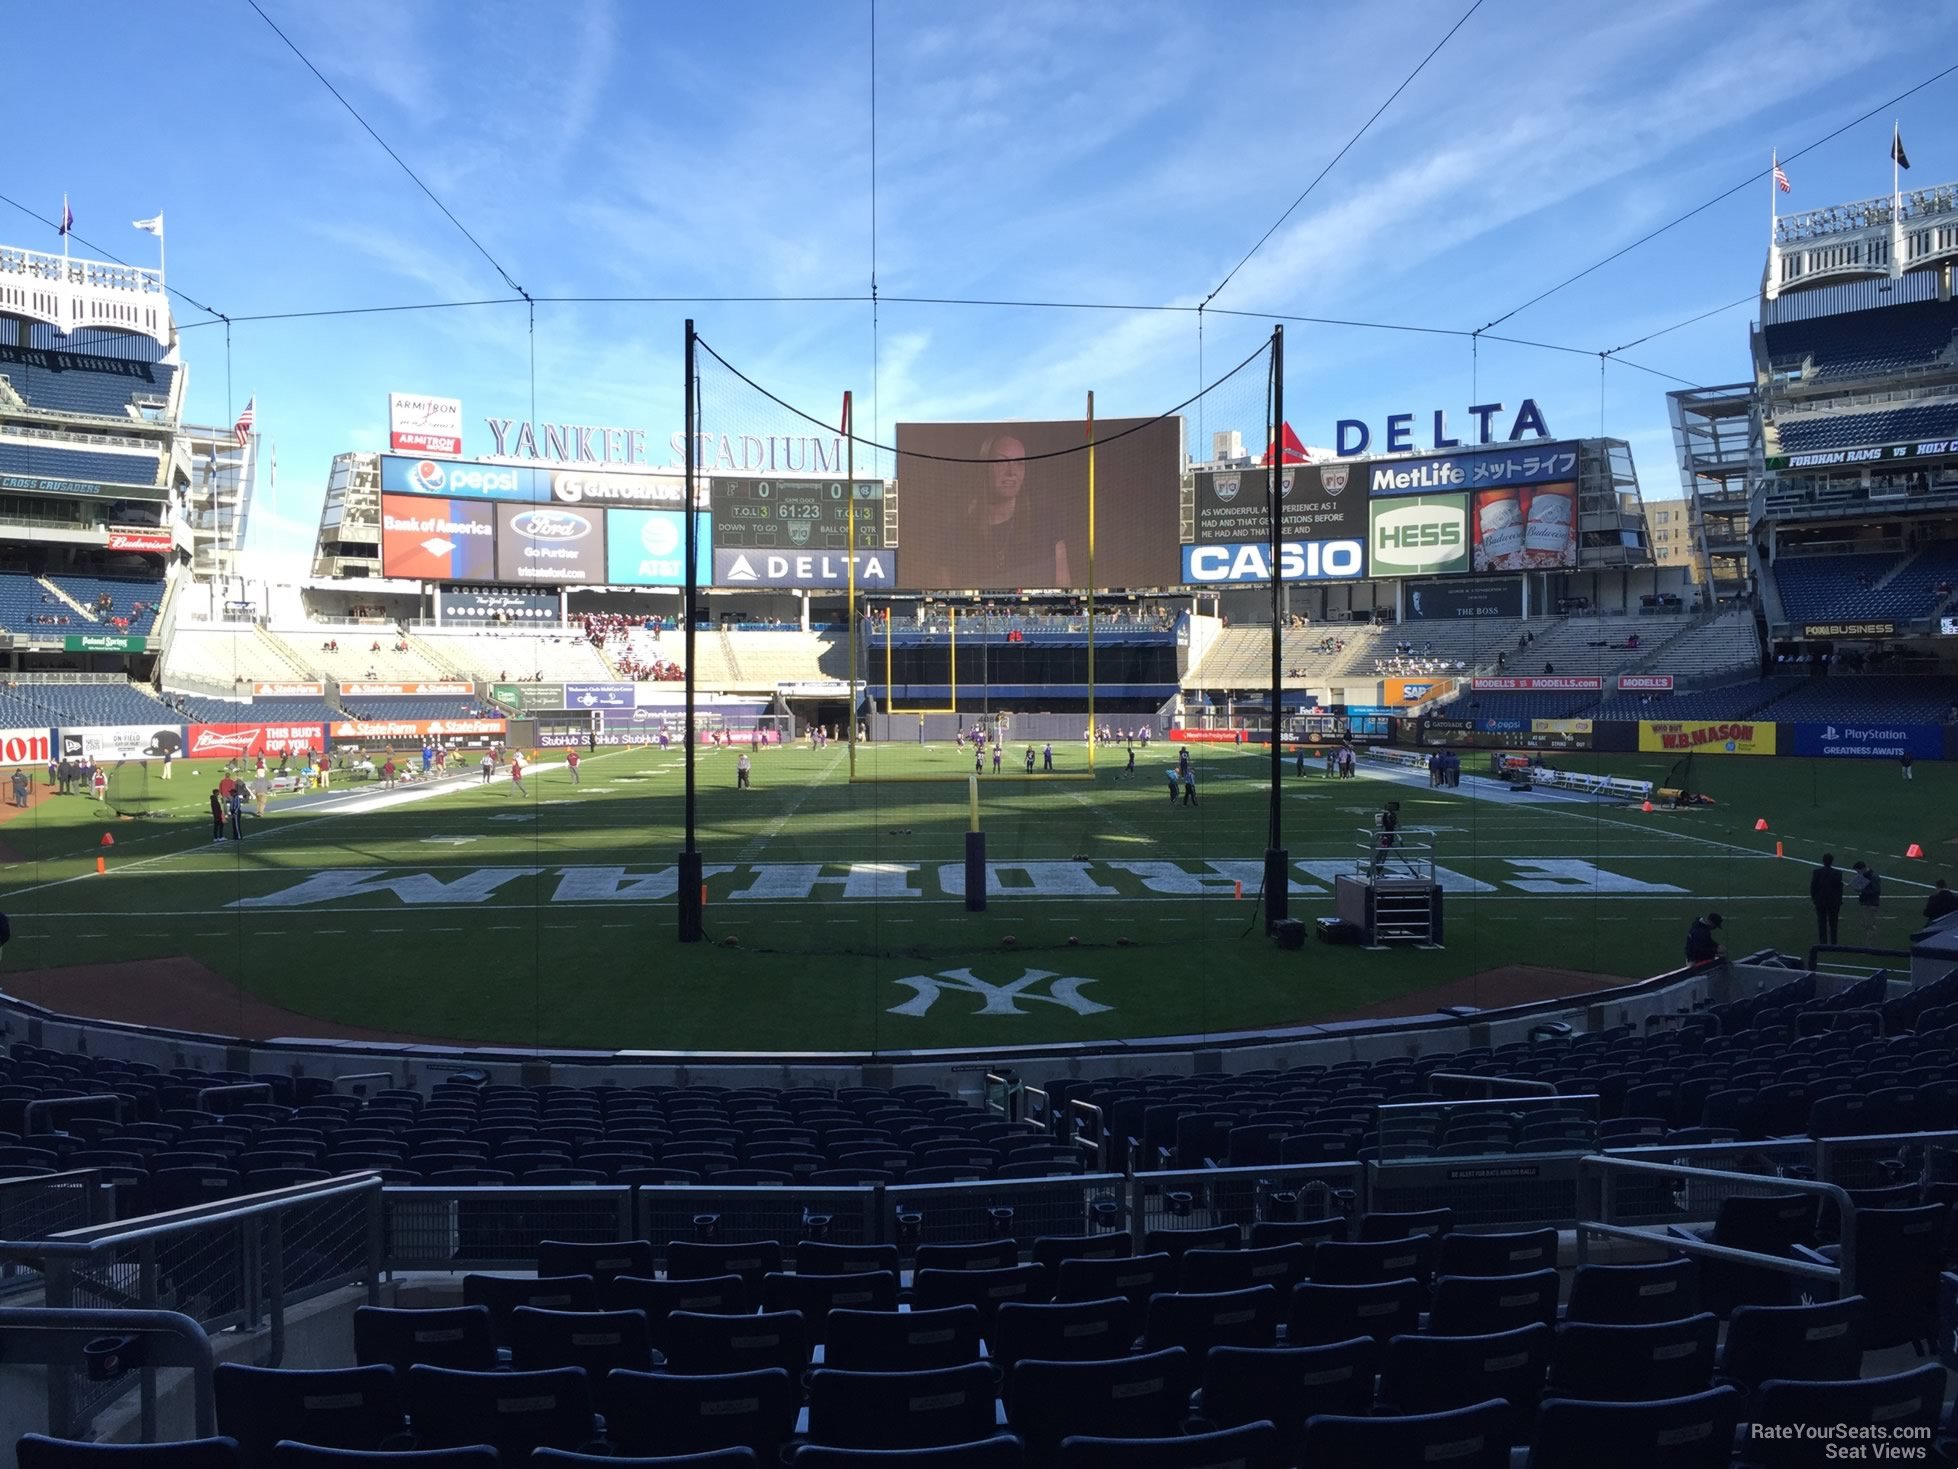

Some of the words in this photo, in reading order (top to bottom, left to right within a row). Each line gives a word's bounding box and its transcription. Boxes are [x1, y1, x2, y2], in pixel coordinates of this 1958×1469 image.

[396, 400, 457, 414] ARMITRON
[1336, 398, 1552, 458] DELTA
[399, 434, 456, 448] ARMITRON
[484, 417, 646, 467] YANKEE
[669, 431, 846, 474] STADIUM
[1789, 453, 1843, 468] FORDHAM
[1846, 448, 1882, 461] RAMS
[1916, 442, 1948, 455] HOLY
[1373, 461, 1466, 491] MetLife
[1473, 453, 1577, 482] メットライフ
[2, 478, 37, 488] CROSS
[39, 482, 101, 494] CRUSADERS
[449, 470, 518, 493] pepsi
[584, 482, 680, 501] GATORADE
[758, 481, 769, 498] 0
[830, 483, 842, 499] 0
[760, 506, 768, 517] 3
[779, 504, 820, 518] 61:23
[863, 508, 871, 519] 3
[1201, 509, 1212, 517] AS
[1213, 506, 1260, 515] WONDERFUL
[384, 515, 419, 531] Bank
[420, 518, 435, 532] of
[436, 519, 493, 535] America
[526, 516, 575, 538] Ford
[1201, 519, 1217, 528] HAD
[1238, 518, 1257, 526] THAT
[1314, 514, 1345, 523] BEFORE
[718, 523, 746, 531] DOWN
[752, 524, 763, 532] TO
[765, 524, 778, 532] GO
[820, 526, 839, 534] BALL
[860, 527, 877, 535] QTR
[1232, 529, 1249, 537] AND
[111, 536, 171, 548] Budweiser
[1379, 522, 1461, 550] HESS
[524, 547, 539, 558] Go
[541, 549, 579, 559] Further
[1190, 540, 1362, 580] CASIO
[639, 560, 683, 577] AT&T
[768, 556, 885, 579] DELTA
[518, 568, 586, 580] tristateford.com
[1456, 608, 1474, 616] THE
[1476, 606, 1498, 615] BOSS
[1830, 624, 1893, 634] BUSINESS
[82, 636, 105, 646] Poland
[105, 637, 128, 648] Spring
[1475, 680, 1515, 688] MODELL'S
[1532, 679, 1597, 688] MODELLS.com
[1622, 678, 1667, 687] MODELL'S
[1300, 706, 1323, 715] FedEx
[1497, 721, 1520, 729] pepsi
[266, 728, 288, 738] THIS
[291, 727, 320, 737] BUD'S
[1845, 729, 1906, 741] PlayStation
[198, 736, 254, 746] Budweiser
[289, 739, 308, 749] YOU
[542, 736, 577, 746] StubHub
[622, 735, 659, 744] StubHub
[0, 737, 48, 761] on
[1824, 746, 1871, 755] GREATNESS
[1872, 747, 1905, 755] AWAITS
[223, 864, 1692, 907] FORDHAM
